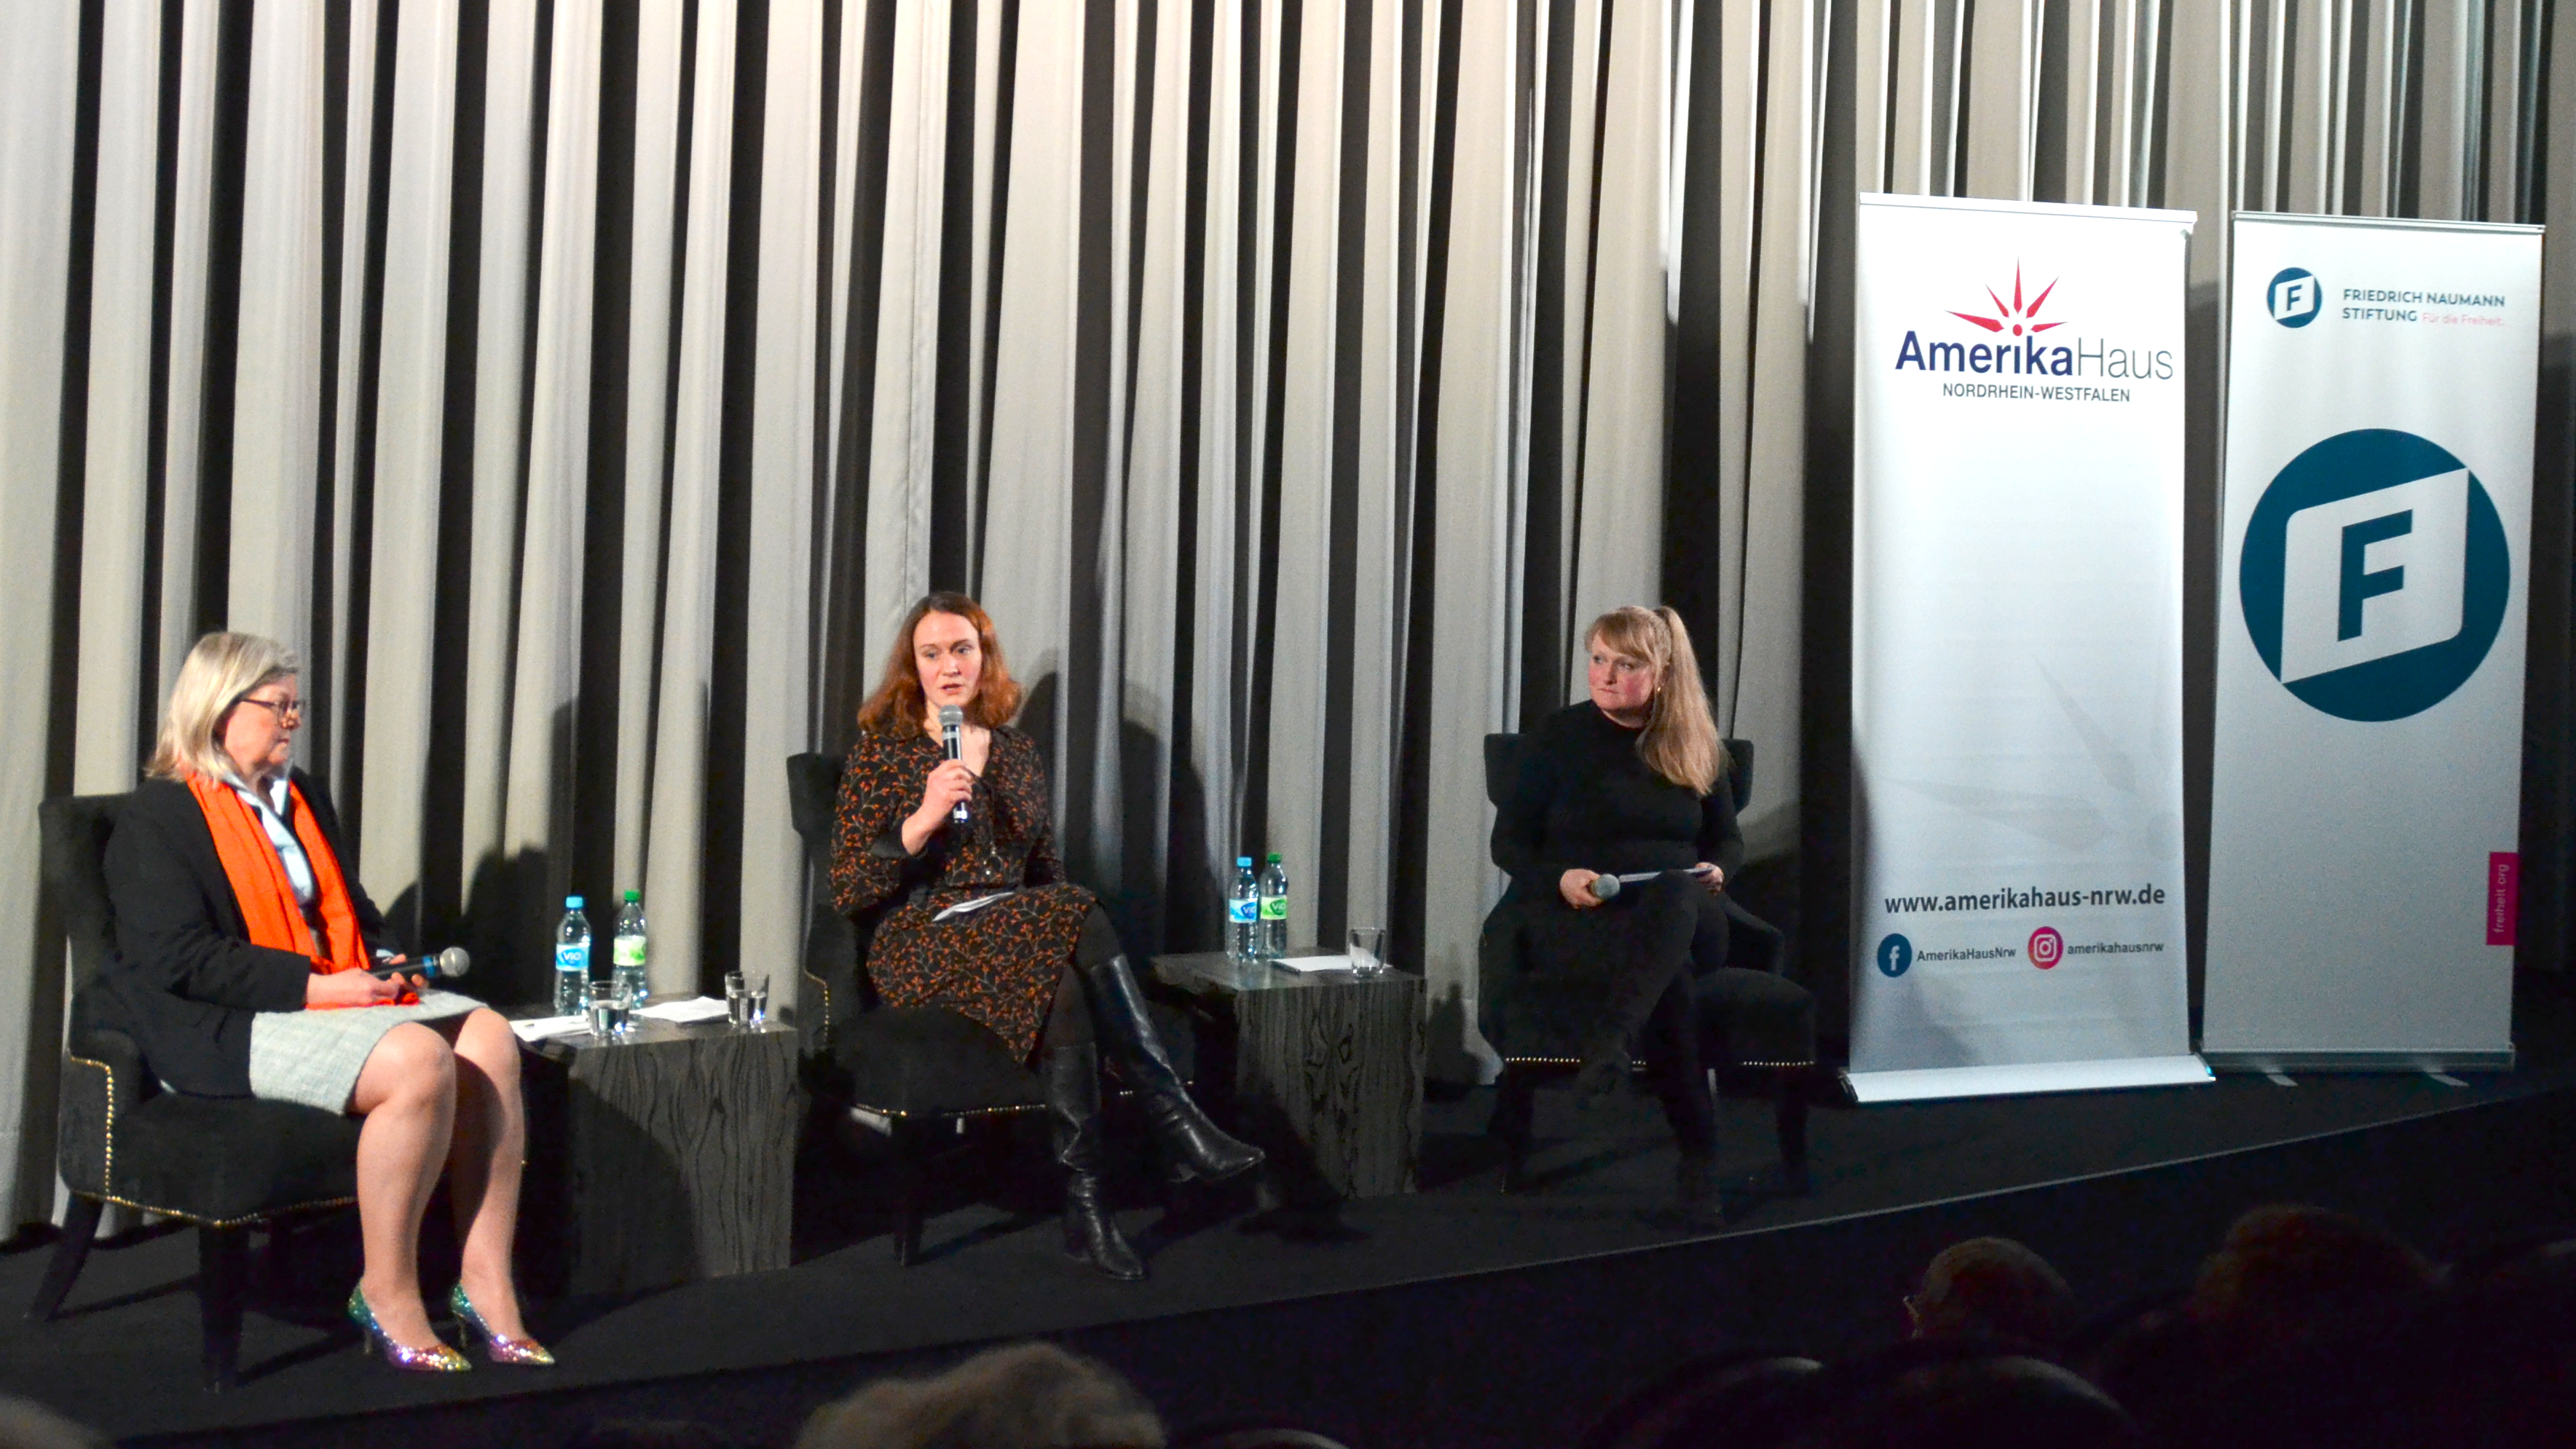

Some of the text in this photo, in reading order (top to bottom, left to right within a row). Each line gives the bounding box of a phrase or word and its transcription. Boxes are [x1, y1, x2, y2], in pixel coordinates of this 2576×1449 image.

[2343, 288, 2505, 307] FRIEDRICH NAUMANN
[2342, 307, 2418, 322] STIFTUNG
[2422, 312, 2440, 323] Für
[2442, 314, 2458, 324] die
[1895, 330, 2173, 380] AmerikaHaus
[1942, 383, 2131, 402] NORDRHEIN-WESTFALEN
[2337, 508, 2414, 641] F
[1885, 883, 2165, 913] www.amerikahaus-nrw.de
[1916, 947, 2017, 962] AmerikaHausNrw
[2067, 941, 2165, 955] amerikahausnrw
